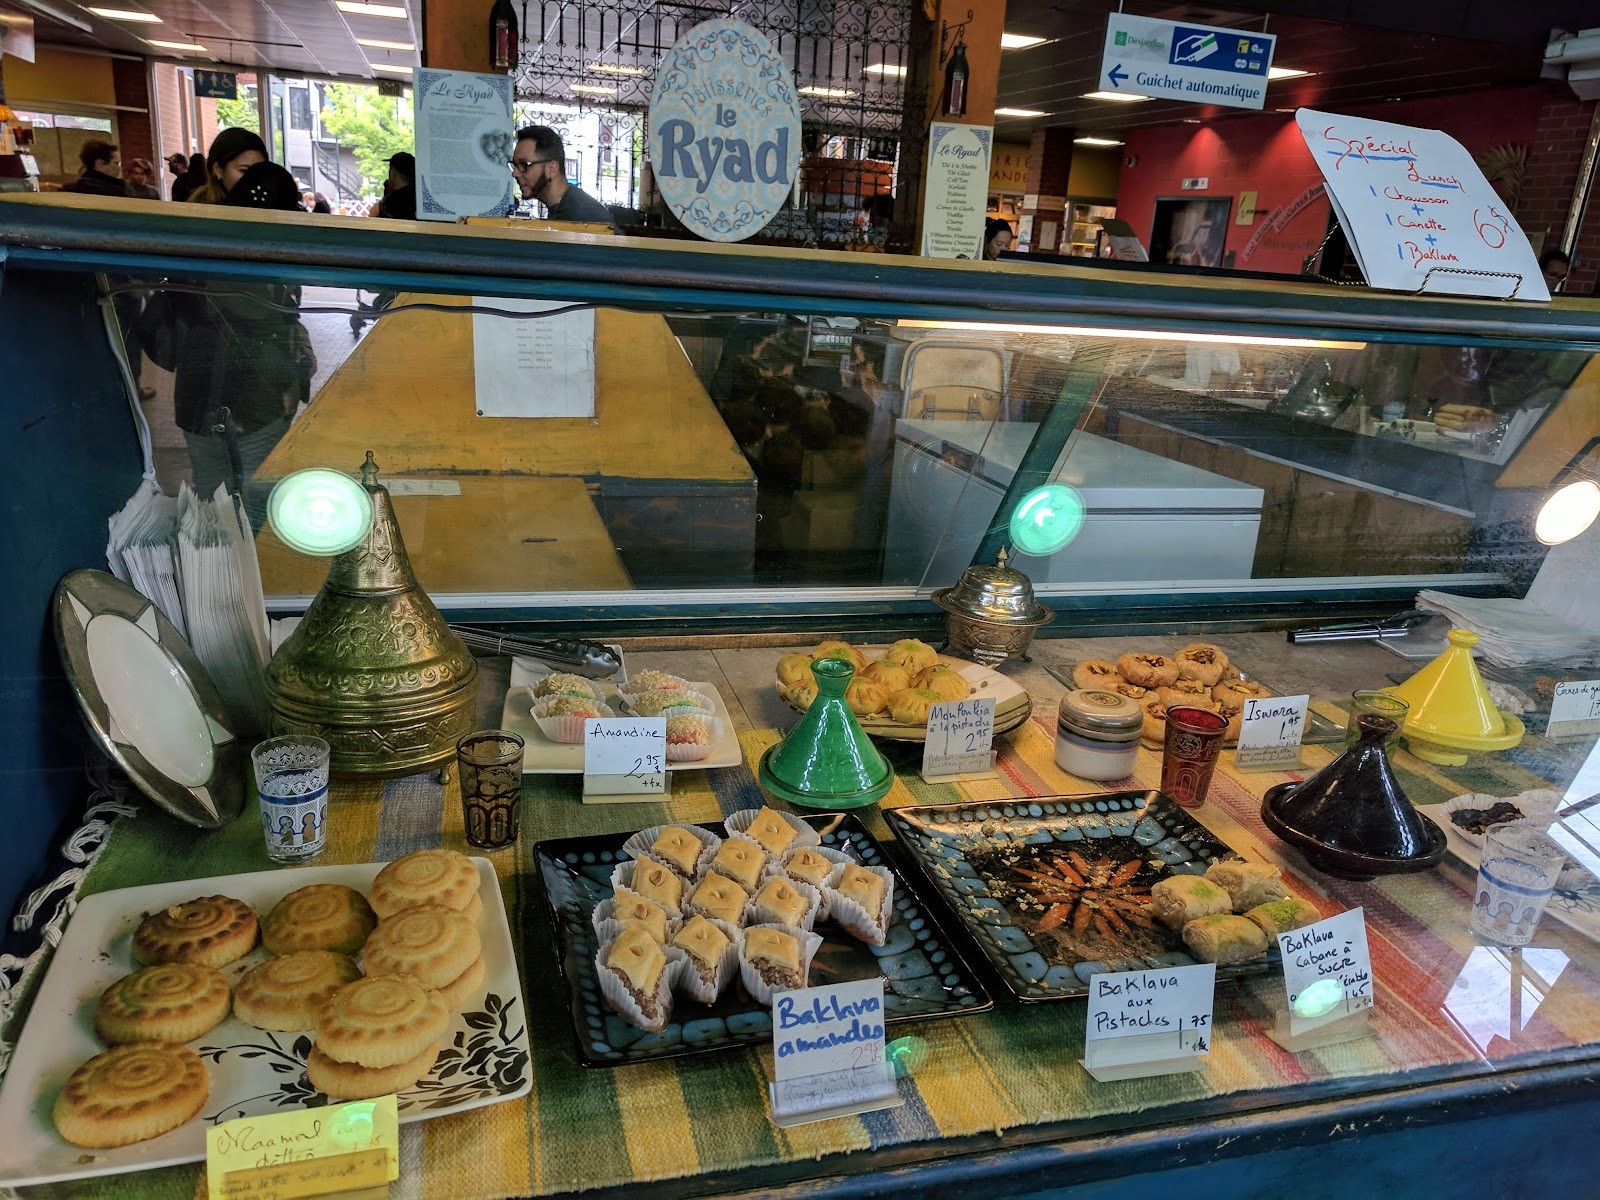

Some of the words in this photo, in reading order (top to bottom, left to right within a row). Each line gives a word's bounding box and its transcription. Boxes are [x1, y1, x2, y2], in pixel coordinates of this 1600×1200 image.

[1128, 35, 1165, 49] Desjardins
[431, 82, 452, 97] Le
[453, 84, 494, 104] Ryad
[1136, 72, 1183, 90] Guichet
[1186, 80, 1260, 102] automatique
[715, 103, 737, 128] le
[657, 119, 790, 194] Ryad
[937, 144, 950, 156] Le
[951, 145, 982, 160] Ryad
[1324, 126, 1418, 170] Spécial
[1407, 159, 1466, 193] Lunch
[1384, 186, 1450, 205] Chausson
[1397, 214, 1447, 231] Canette
[590, 722, 666, 738] Amandine
[777, 994, 881, 1030] Baklava
[1127, 997, 1153, 1008] aux
[1094, 1009, 1170, 1033] Pistaches
[777, 1018, 884, 1059] amandes
